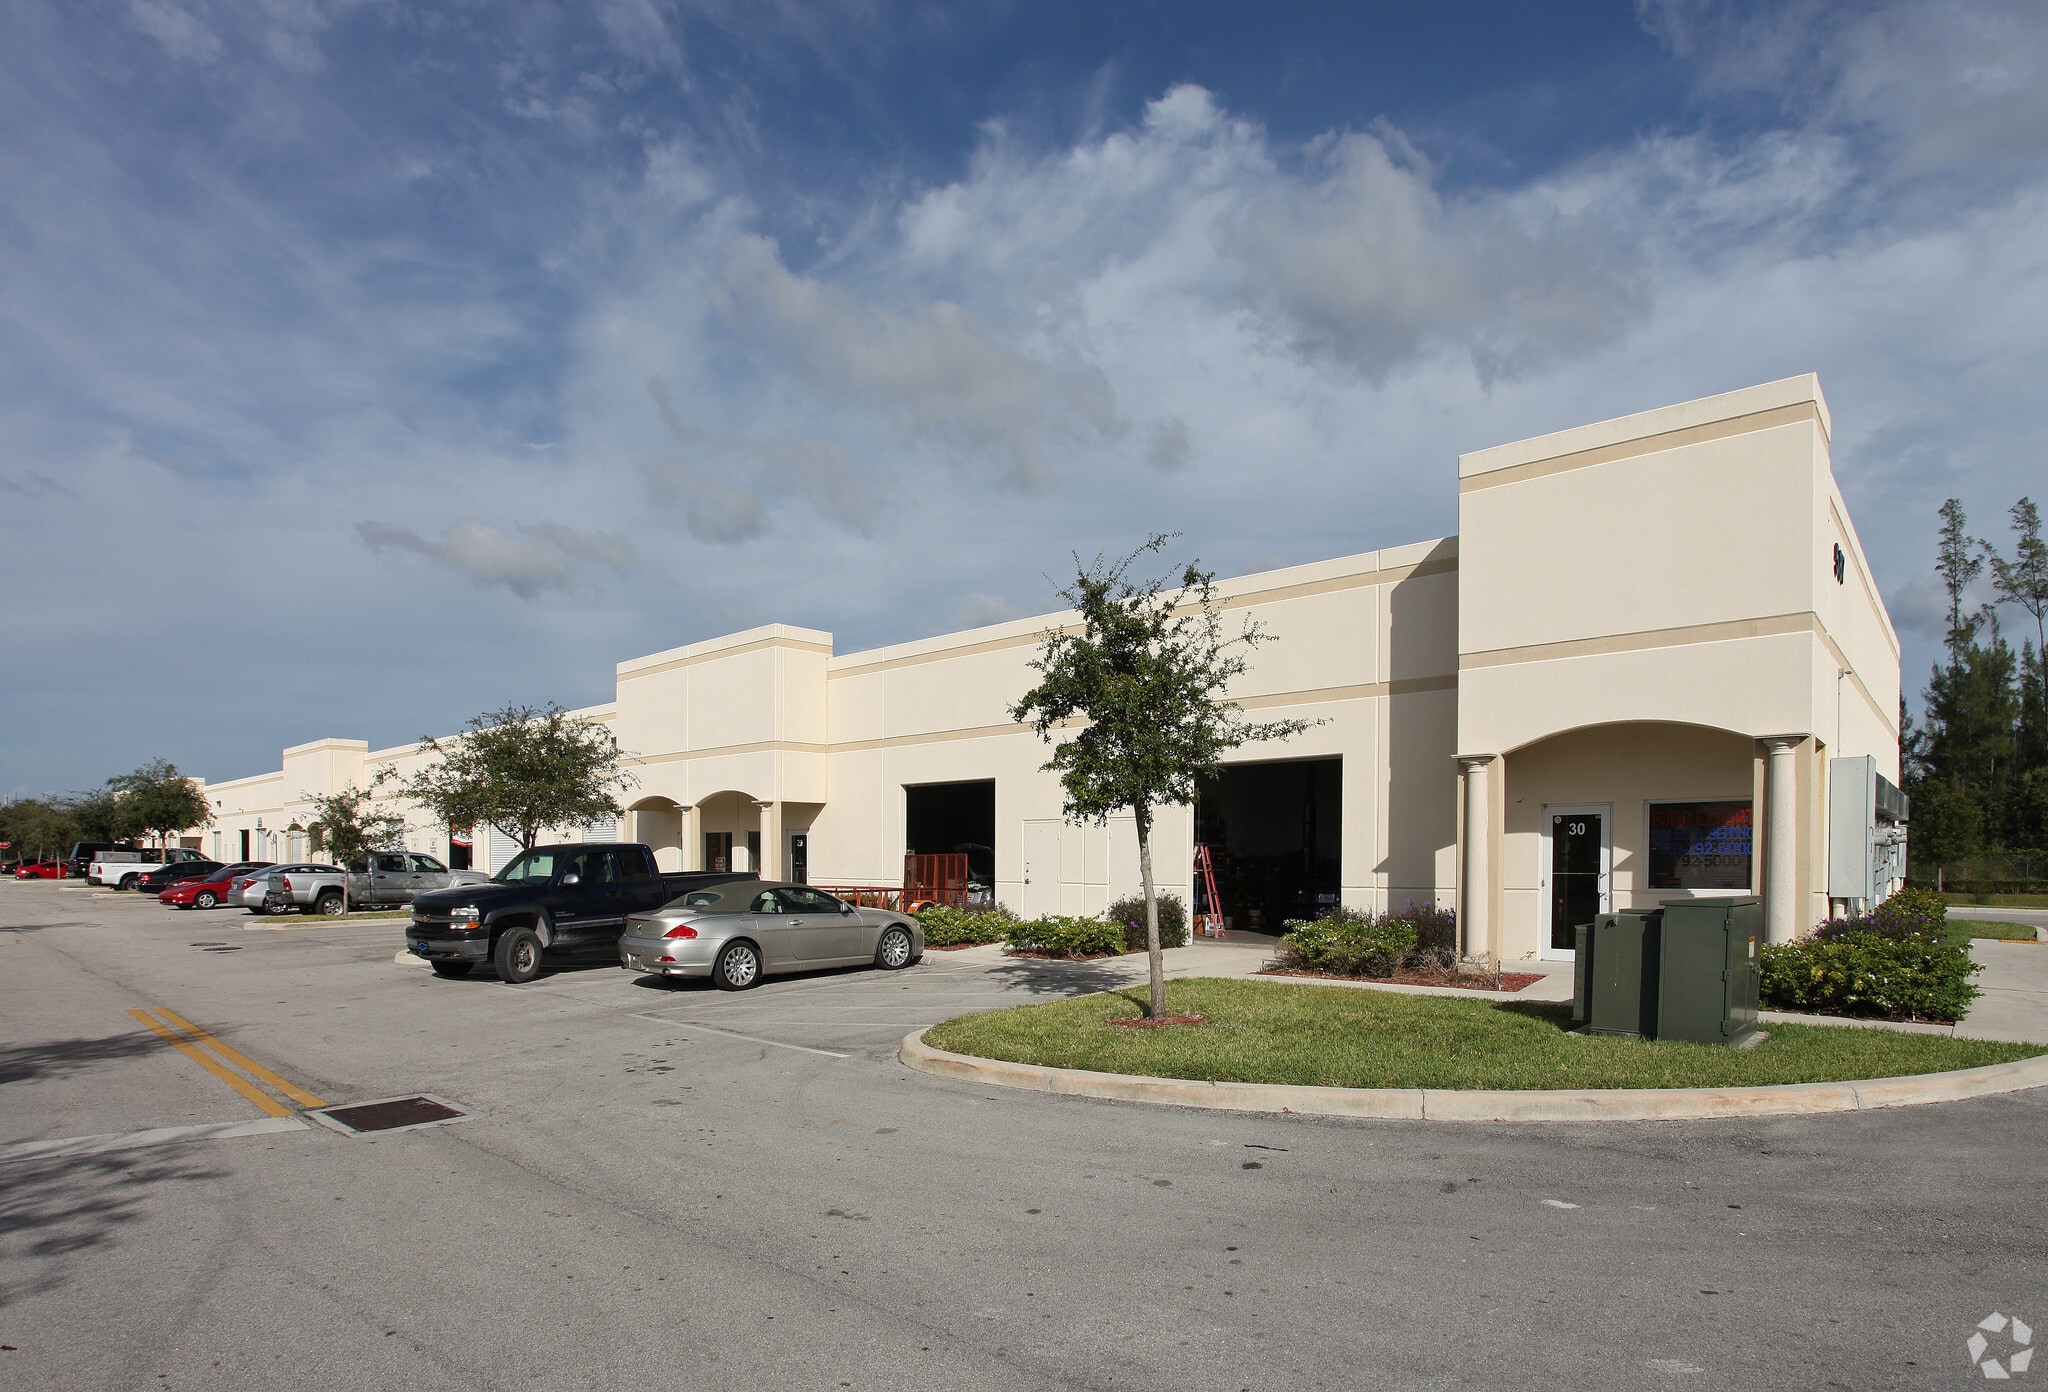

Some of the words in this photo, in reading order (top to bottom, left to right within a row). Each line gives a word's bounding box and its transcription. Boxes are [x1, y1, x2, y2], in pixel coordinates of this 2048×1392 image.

[1651, 810, 1692, 828] EURO
[1696, 808, 1753, 827] EXPERT
[1569, 823, 1585, 835] 30
